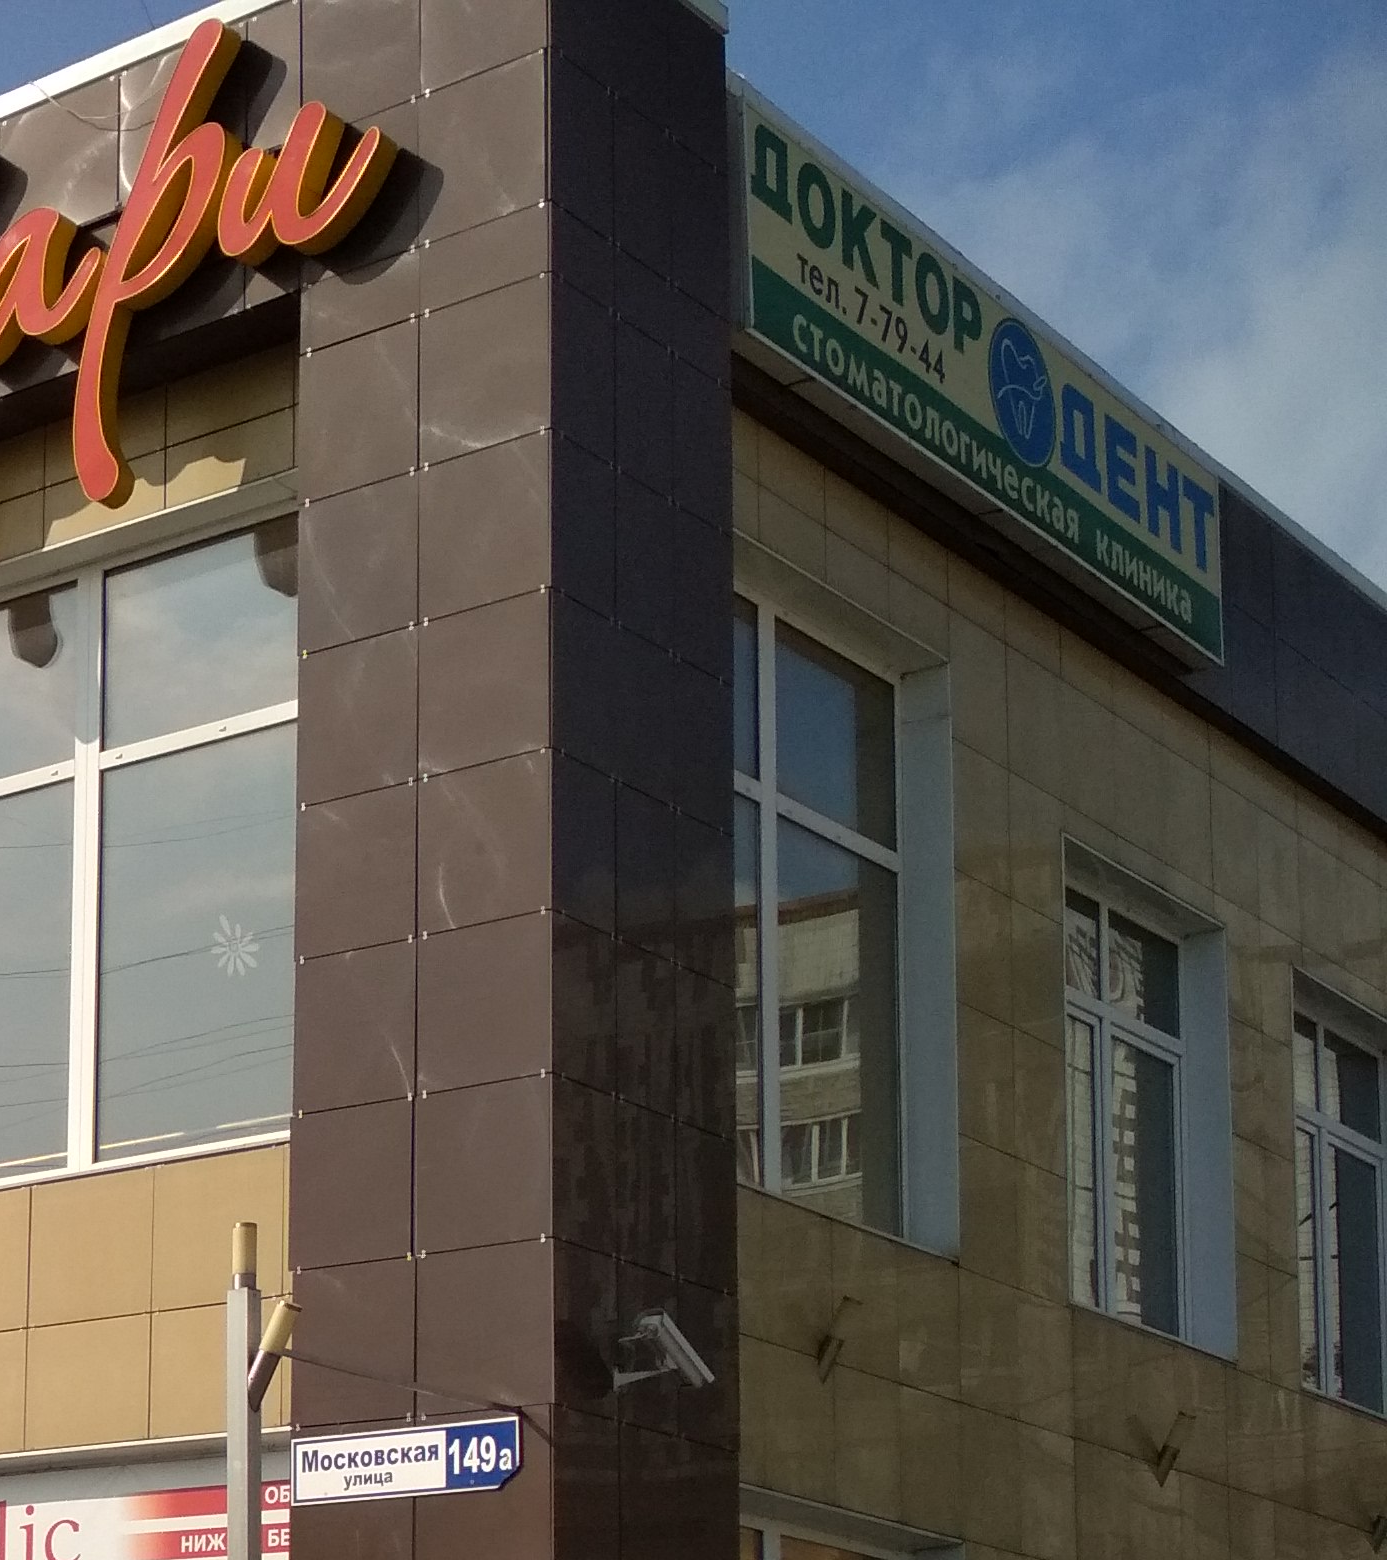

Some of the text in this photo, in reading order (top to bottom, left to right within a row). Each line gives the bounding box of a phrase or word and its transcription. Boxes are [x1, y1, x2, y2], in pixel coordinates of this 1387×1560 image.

[751, 122, 1215, 574] ДОКТОР ДЕНТ
[792, 312, 1194, 625] стоматологическая клиника
[302, 1436, 512, 1475] Московская 149а
[344, 1471, 393, 1491] улица
